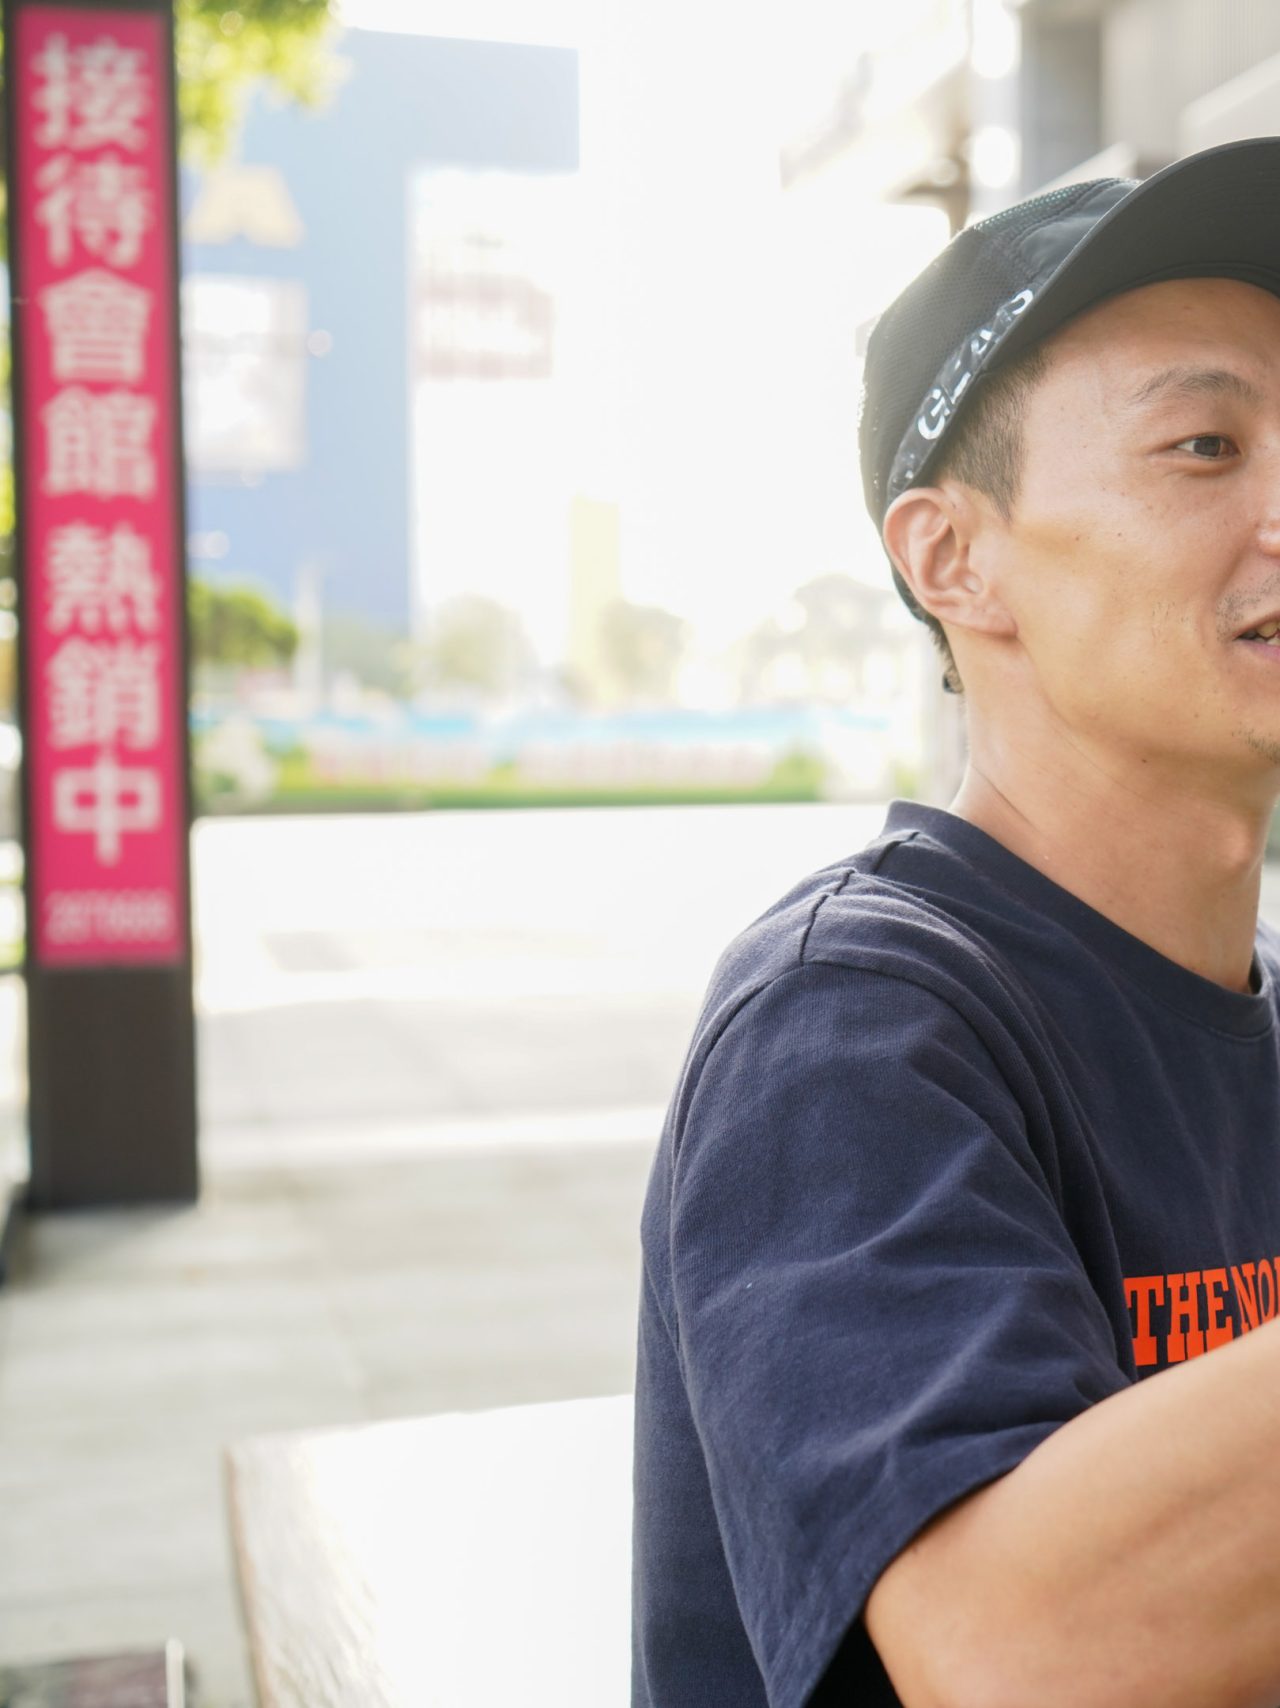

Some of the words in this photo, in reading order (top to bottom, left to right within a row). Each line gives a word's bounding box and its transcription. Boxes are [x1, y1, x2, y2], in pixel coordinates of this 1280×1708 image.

[30, 33, 157, 500] 接待會館
[46, 520, 164, 867] 熱銷中
[1123, 1267, 1234, 1367] THE
